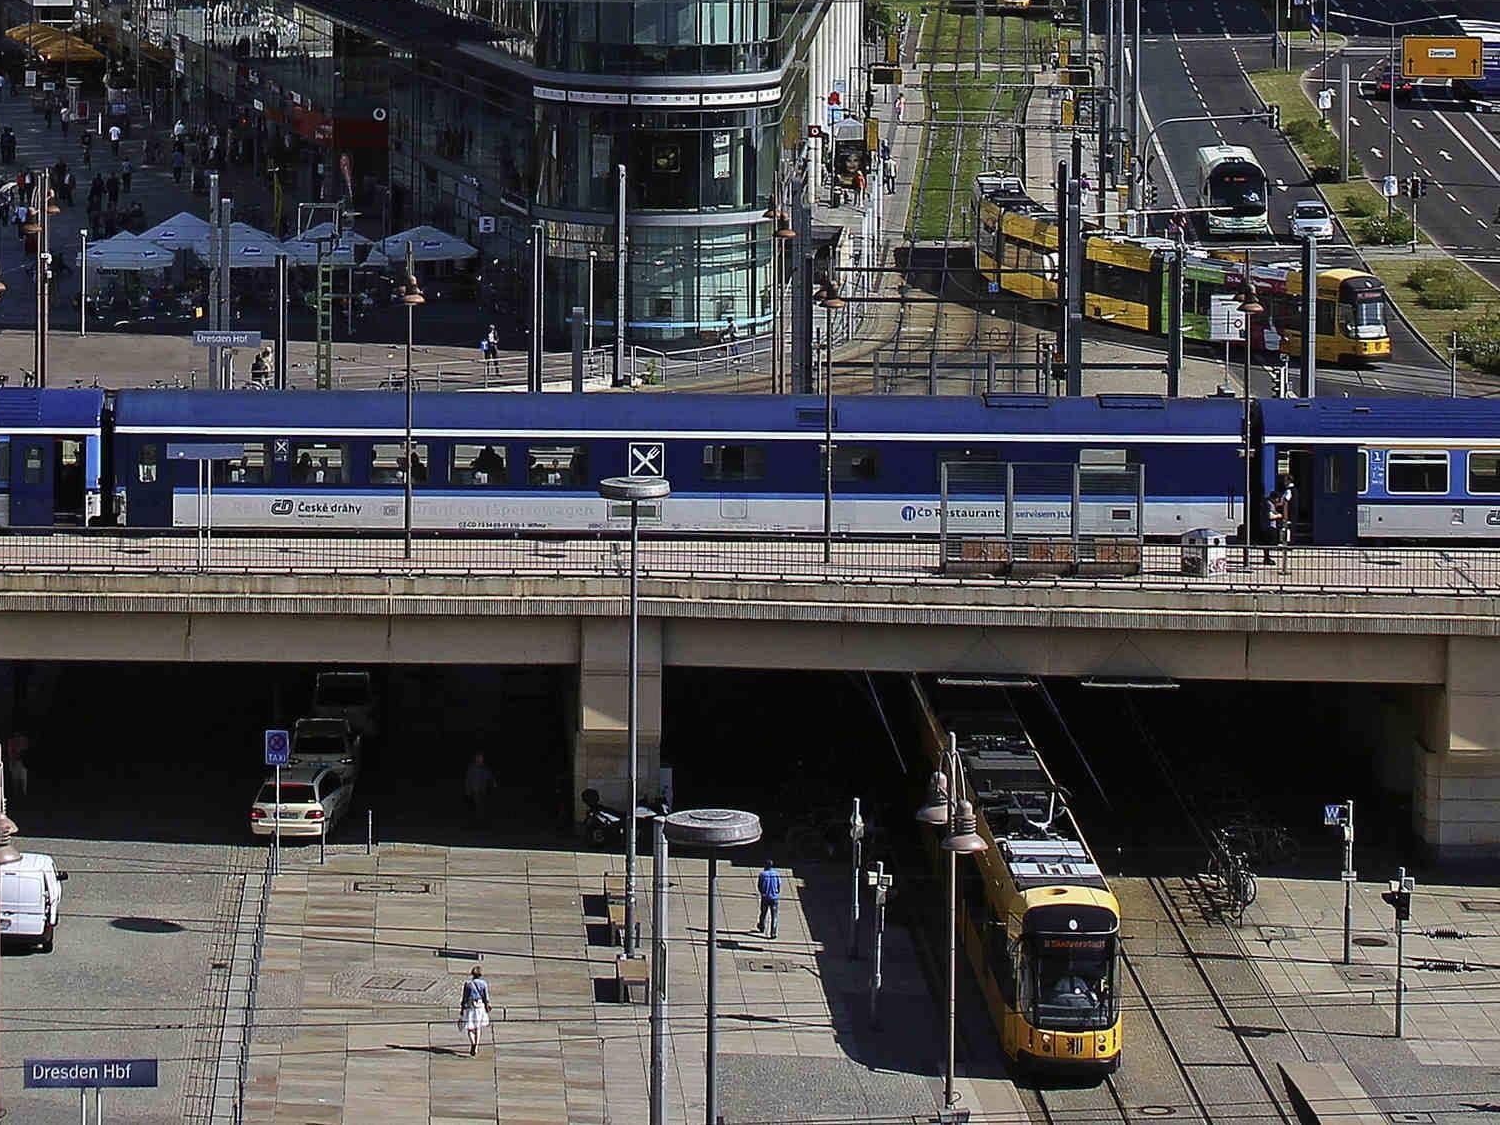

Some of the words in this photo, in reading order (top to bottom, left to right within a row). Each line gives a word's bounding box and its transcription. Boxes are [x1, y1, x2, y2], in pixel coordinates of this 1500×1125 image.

[298, 501, 328, 513] České
[331, 504, 362, 515] dráhy
[935, 508, 1001, 518] Rstaurant
[268, 754, 286, 763] TAXI
[33, 1064, 98, 1080] Dresden
[104, 1063, 132, 1080] Hbf
